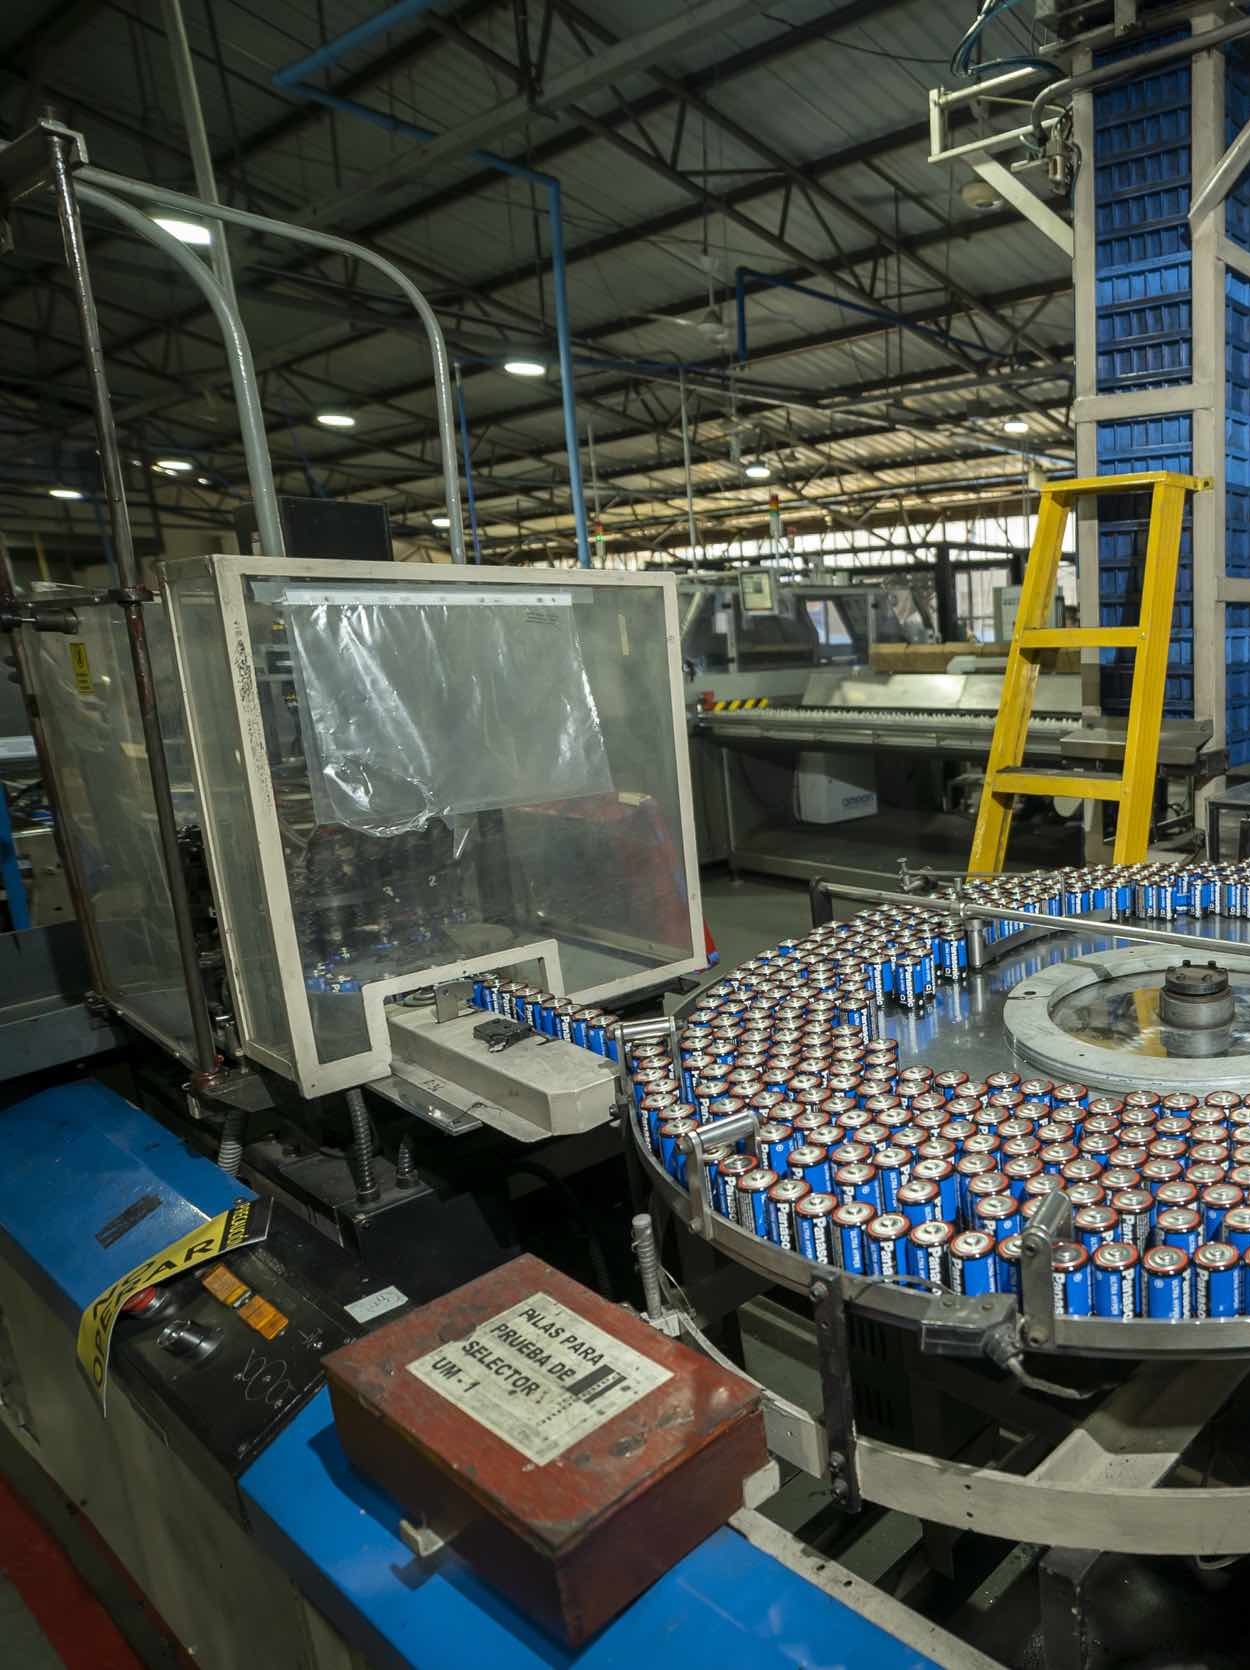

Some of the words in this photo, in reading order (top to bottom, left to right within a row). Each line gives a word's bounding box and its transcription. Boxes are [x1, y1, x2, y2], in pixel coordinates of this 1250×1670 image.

[777, 1203, 791, 1250] Panaso
[813, 1217, 828, 1264] Panaso
[1052, 1273, 1065, 1314] Panas
[1122, 1268, 1135, 1323] Panaso
[490, 1323, 552, 1367] PRUEBA
[547, 1362, 576, 1382] DE
[518, 1307, 561, 1339] PILAS
[560, 1335, 605, 1366] PARA
[462, 1340, 540, 1397] SELECTOR
